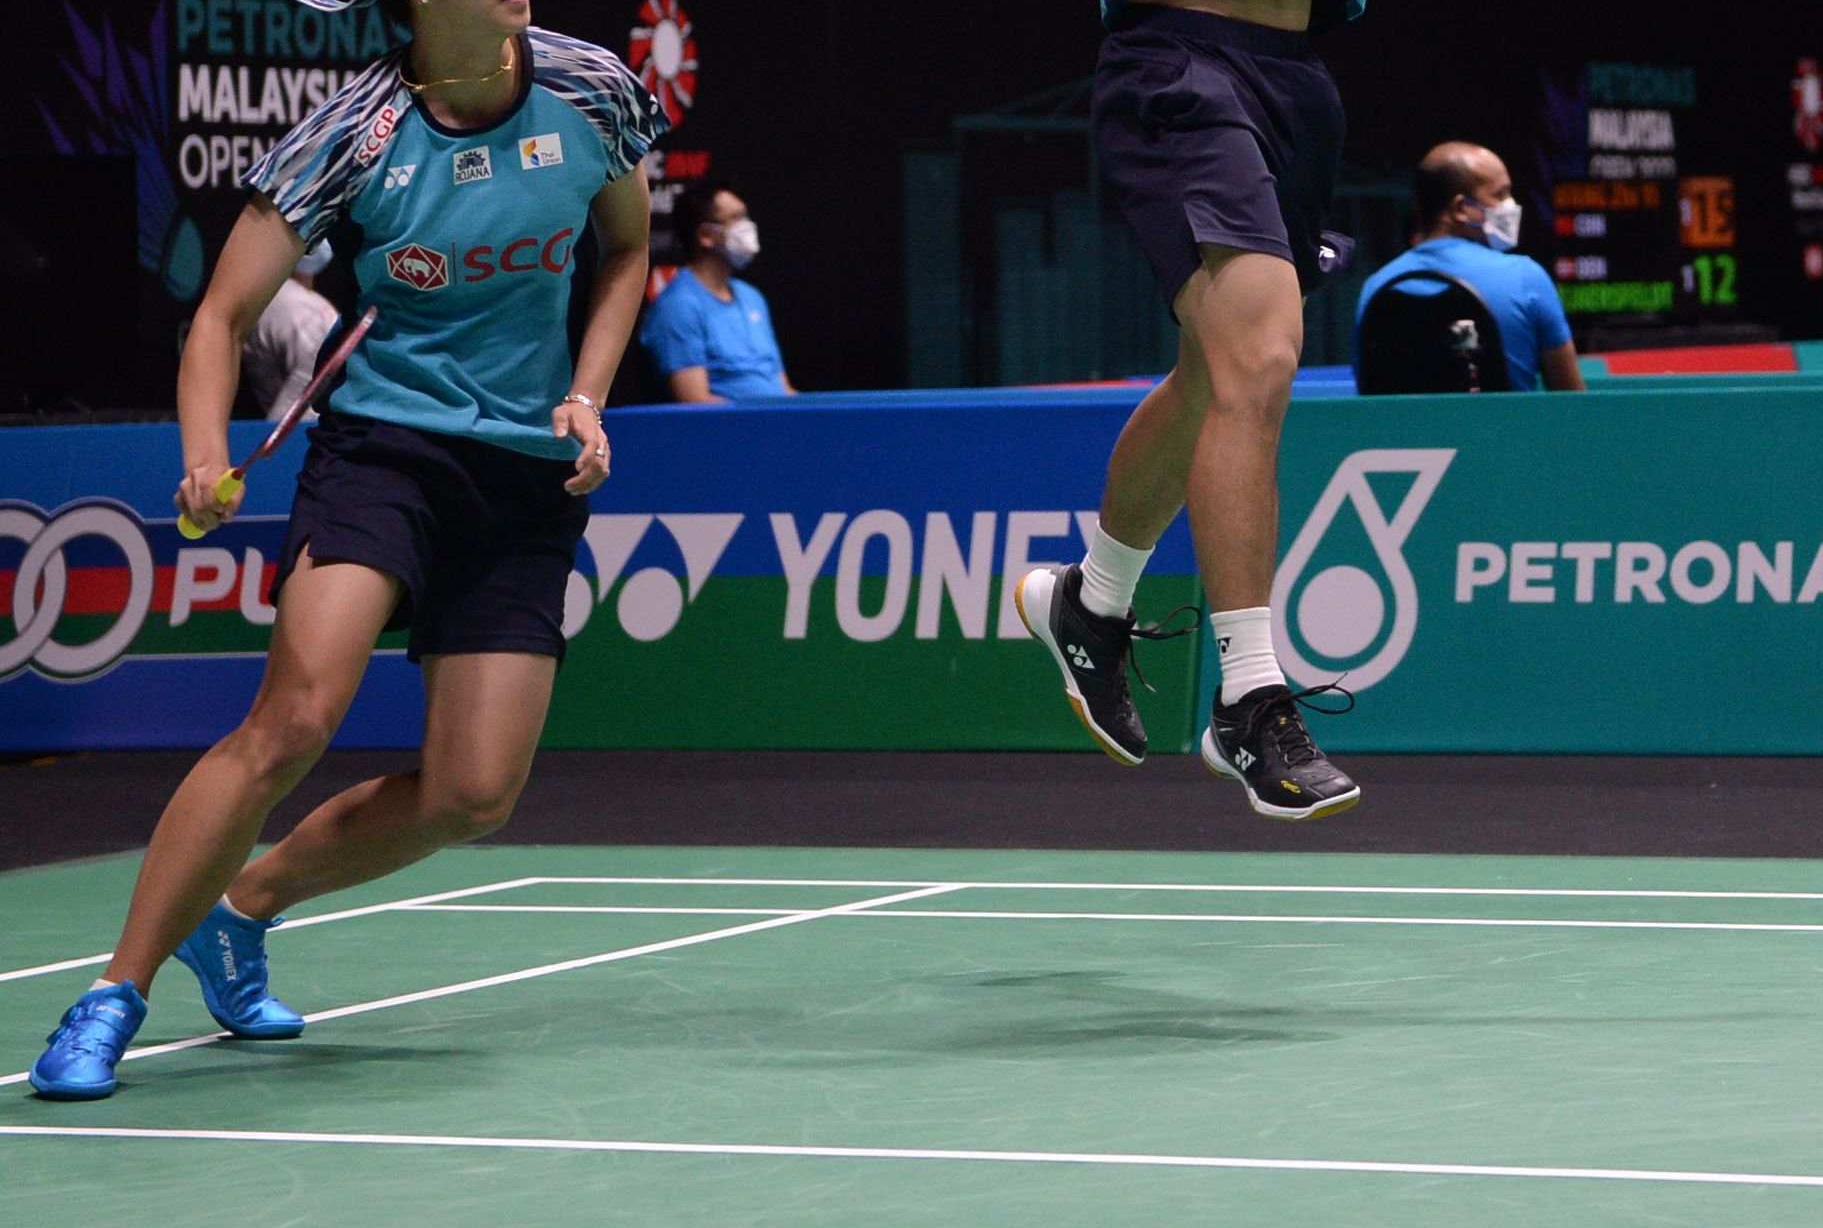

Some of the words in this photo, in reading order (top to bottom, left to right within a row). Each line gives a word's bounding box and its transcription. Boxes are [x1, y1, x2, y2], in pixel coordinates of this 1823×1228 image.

[358, 108, 396, 162] SCGP
[455, 166, 491, 182] ROJANA
[1693, 254, 1737, 305] 12
